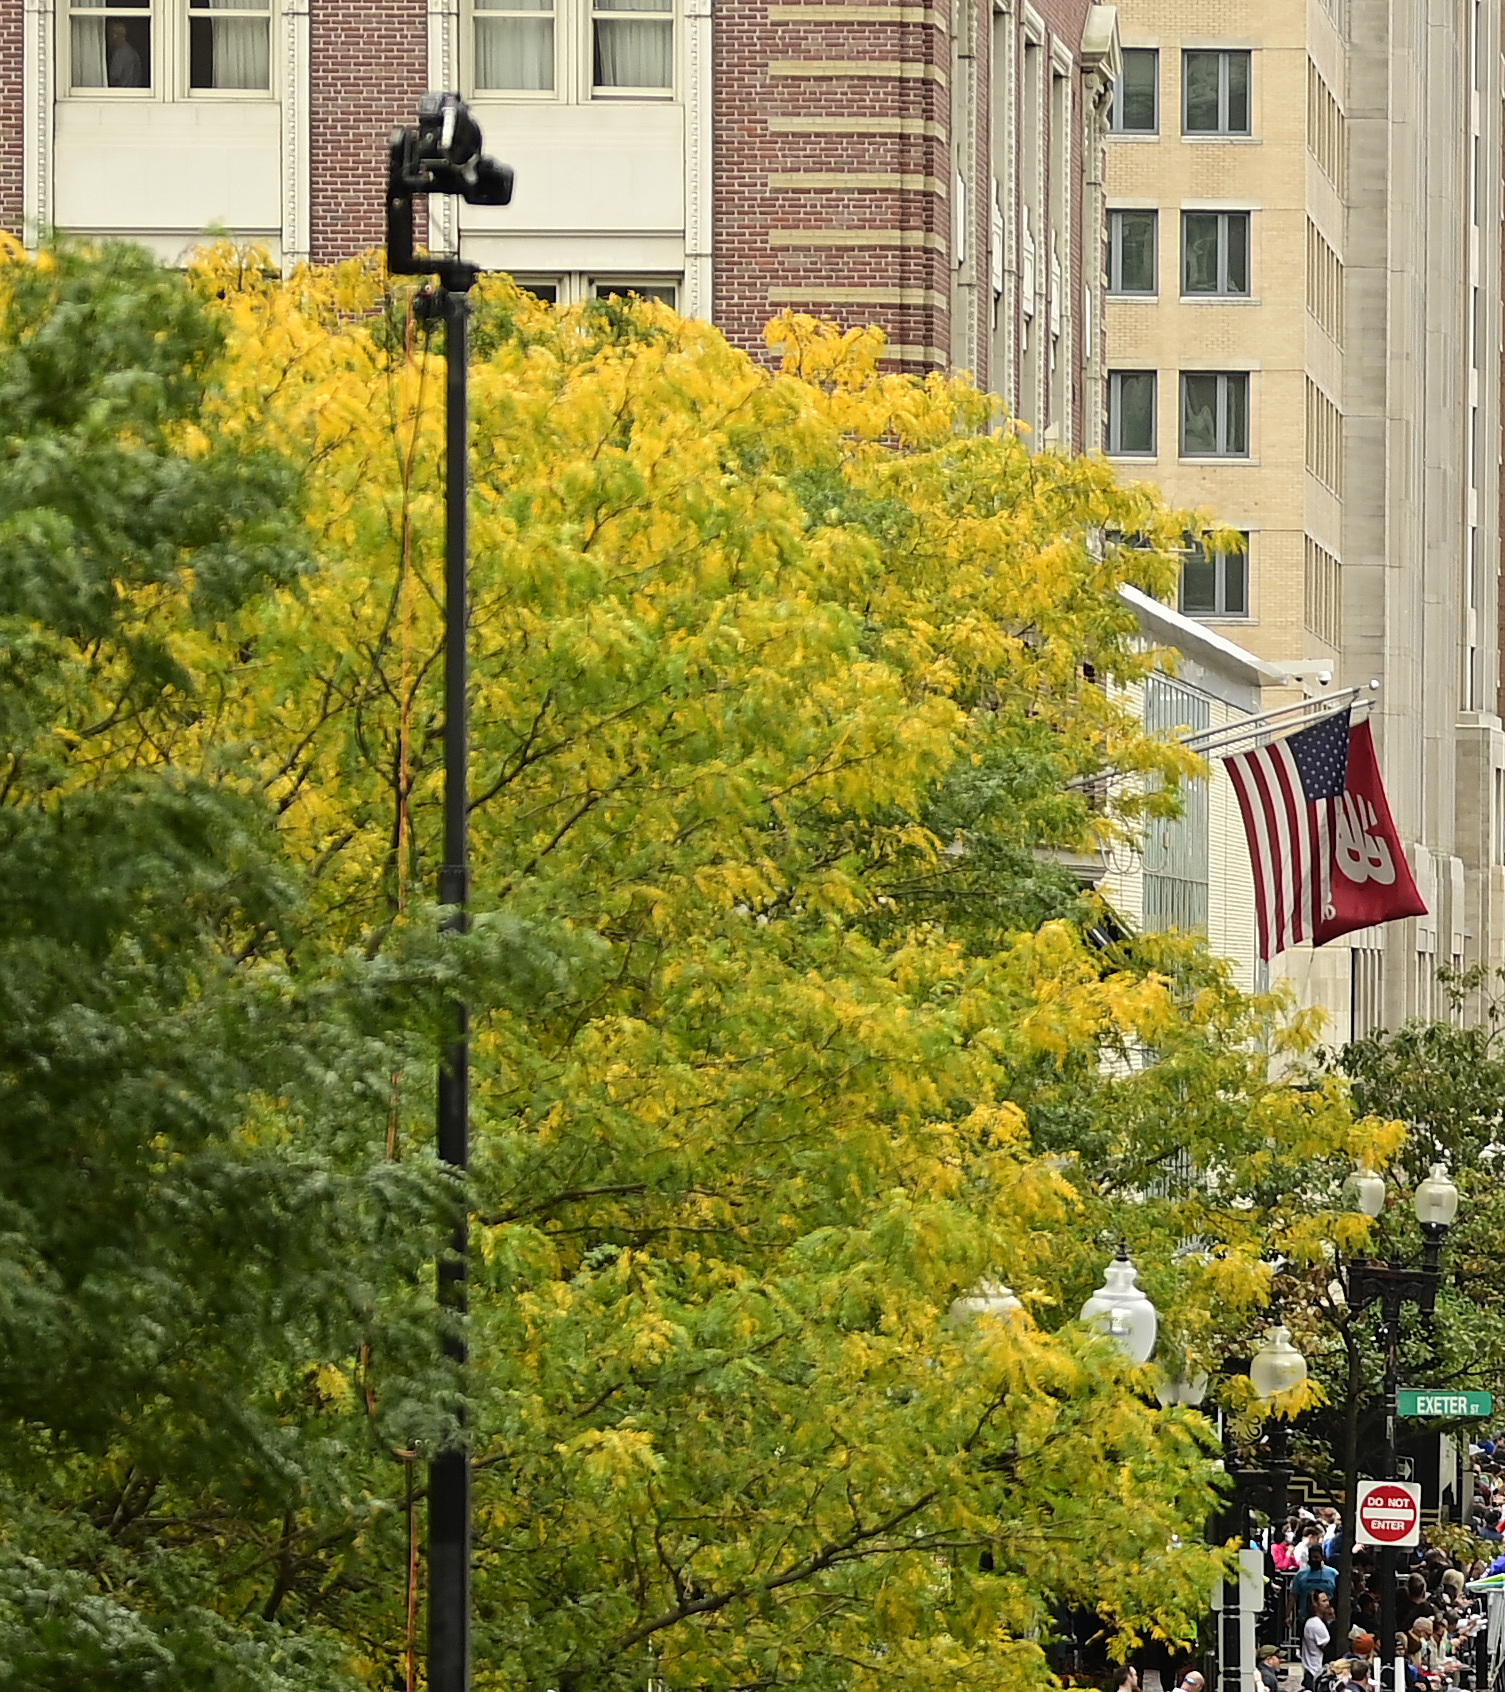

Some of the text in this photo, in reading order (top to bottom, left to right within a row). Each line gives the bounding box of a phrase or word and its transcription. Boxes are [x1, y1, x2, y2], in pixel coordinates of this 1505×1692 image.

[1416, 1396, 1480, 1415] EXETER ST
[1367, 1497, 1411, 1508] DO NOT
[1371, 1519, 1406, 1531] ENTER
